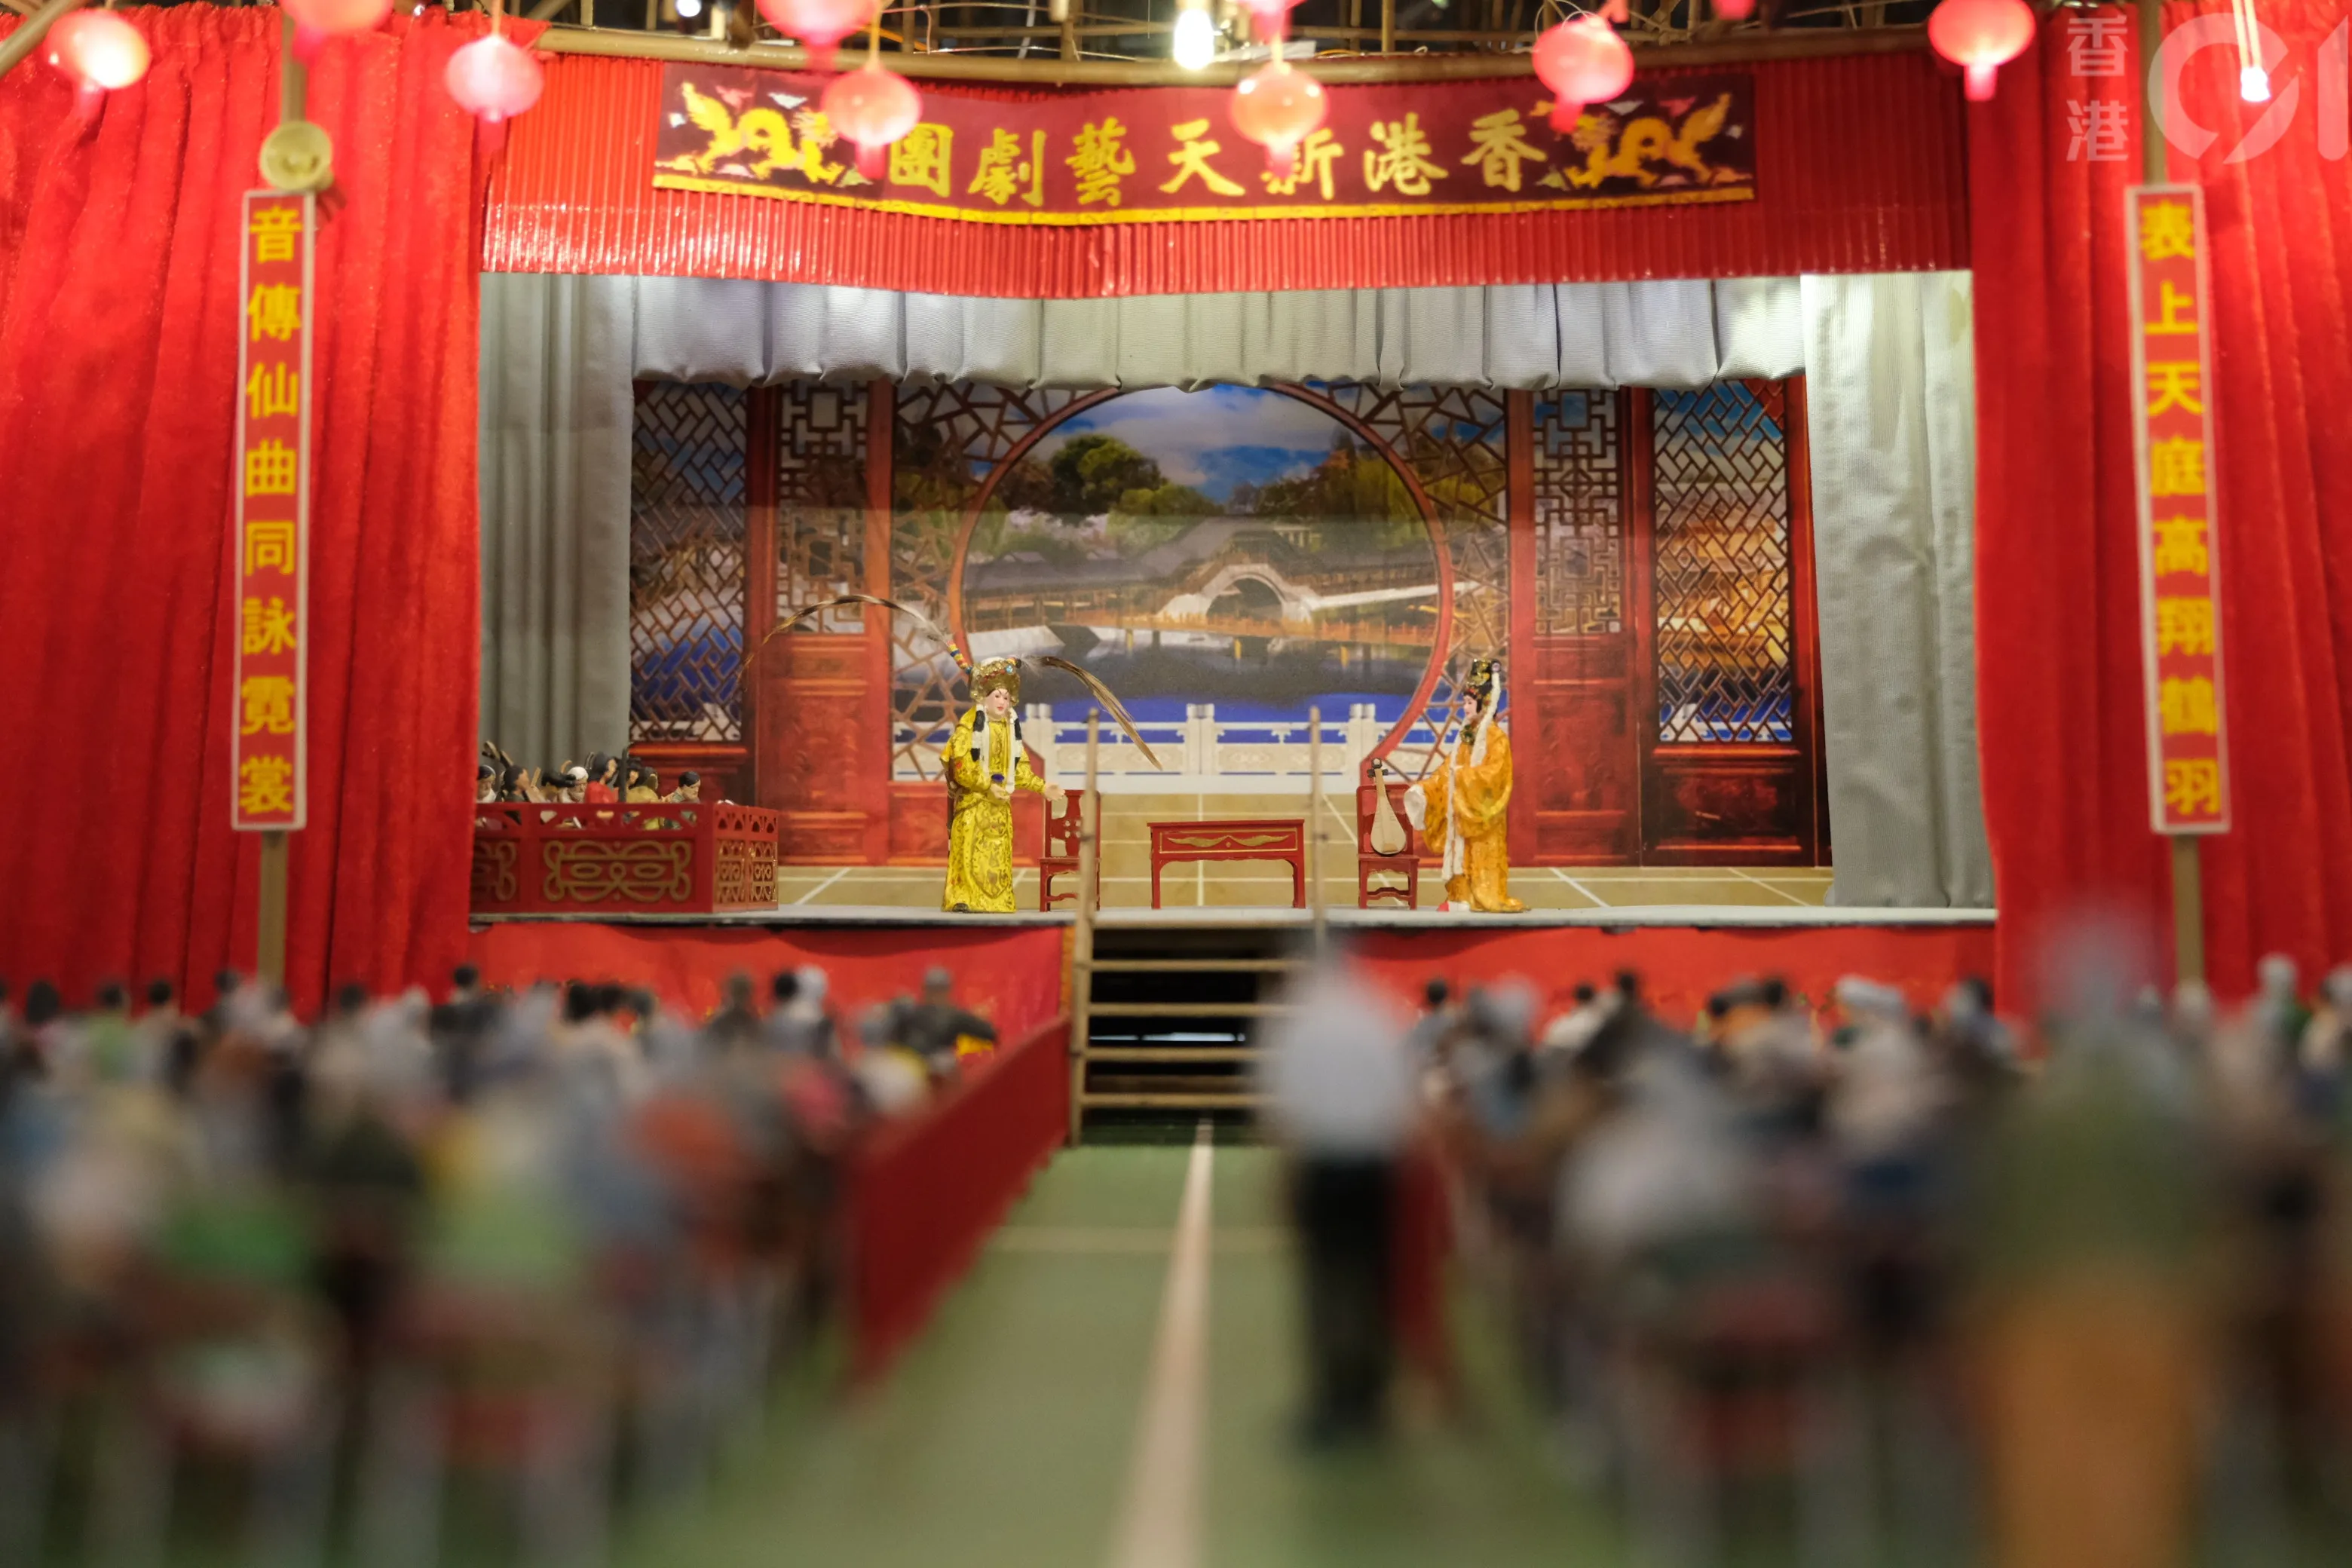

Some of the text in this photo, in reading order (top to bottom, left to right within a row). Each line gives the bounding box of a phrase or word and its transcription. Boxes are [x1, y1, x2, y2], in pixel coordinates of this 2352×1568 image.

[238, 205, 302, 815] 音傳仙曲同詠霓裳
